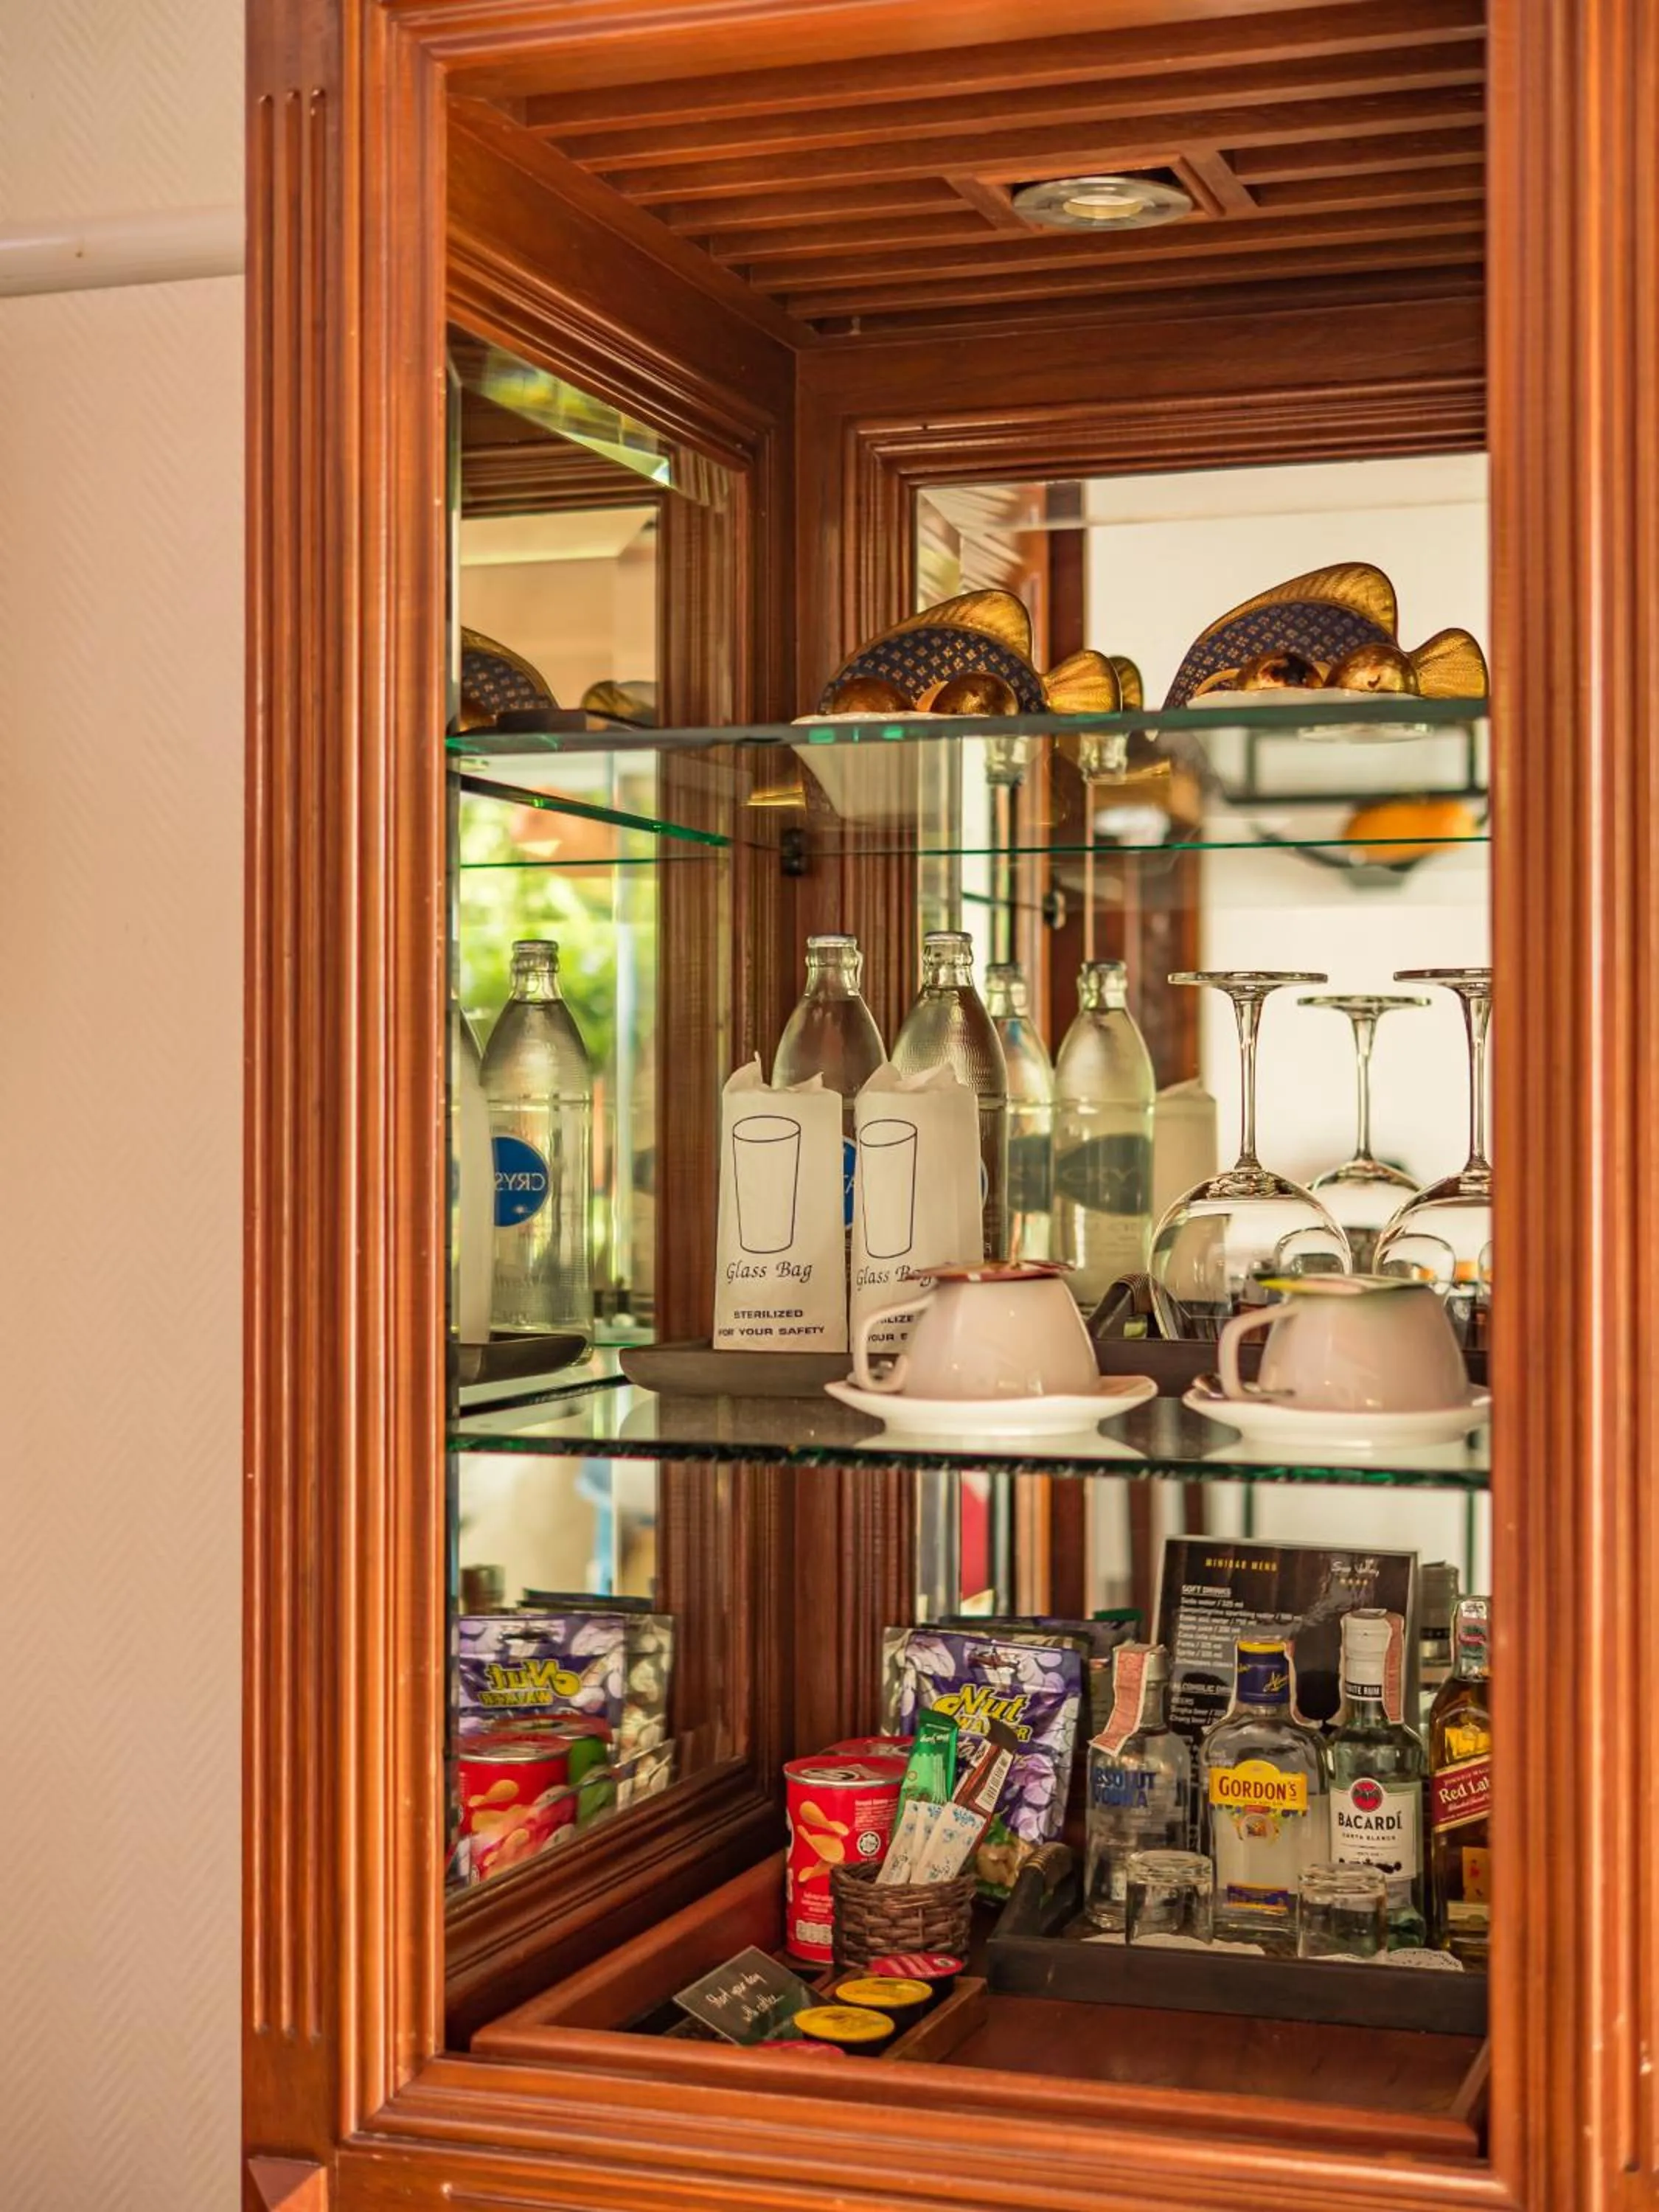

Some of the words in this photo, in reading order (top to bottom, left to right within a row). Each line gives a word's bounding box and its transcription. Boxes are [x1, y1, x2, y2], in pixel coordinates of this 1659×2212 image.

[726, 1259, 768, 1284] Glass
[775, 1260, 813, 1284] Bag
[856, 1266, 890, 1292] Glass
[734, 1310, 804, 1319] STERILIZED
[739, 1328, 773, 1336] YOUR
[779, 1326, 825, 1335] SAFETY
[1363, 1686, 1380, 1695] RUM
[933, 1684, 1031, 1723] Nut
[1218, 1775, 1297, 1801] GORDON'S
[1439, 1783, 1467, 1804] Red
[1338, 1810, 1402, 1830] BACARDÍ
